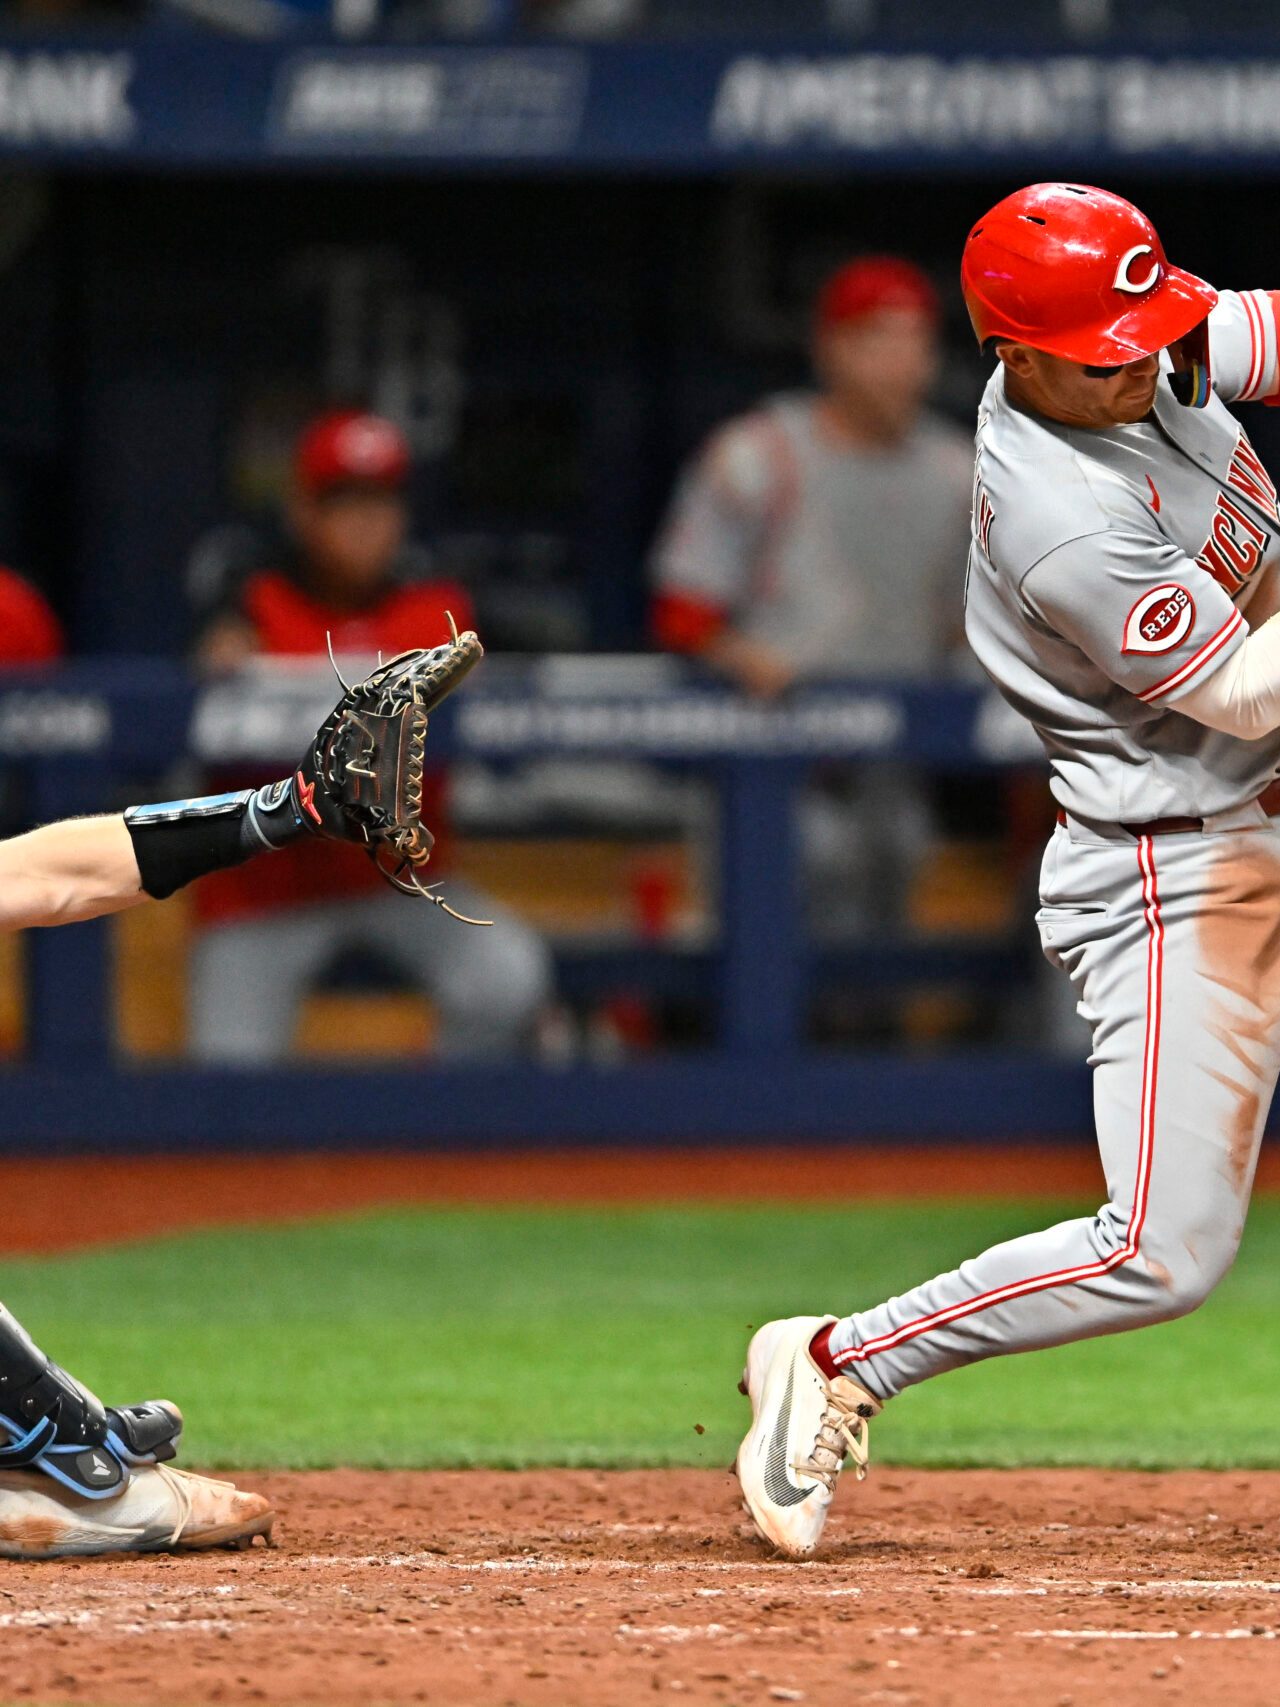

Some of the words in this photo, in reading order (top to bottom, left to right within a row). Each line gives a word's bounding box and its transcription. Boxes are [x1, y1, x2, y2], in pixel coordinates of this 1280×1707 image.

[712, 56, 1096, 150] AMERANT
[1113, 244, 1159, 293] C
[1142, 589, 1188, 639] REDS
